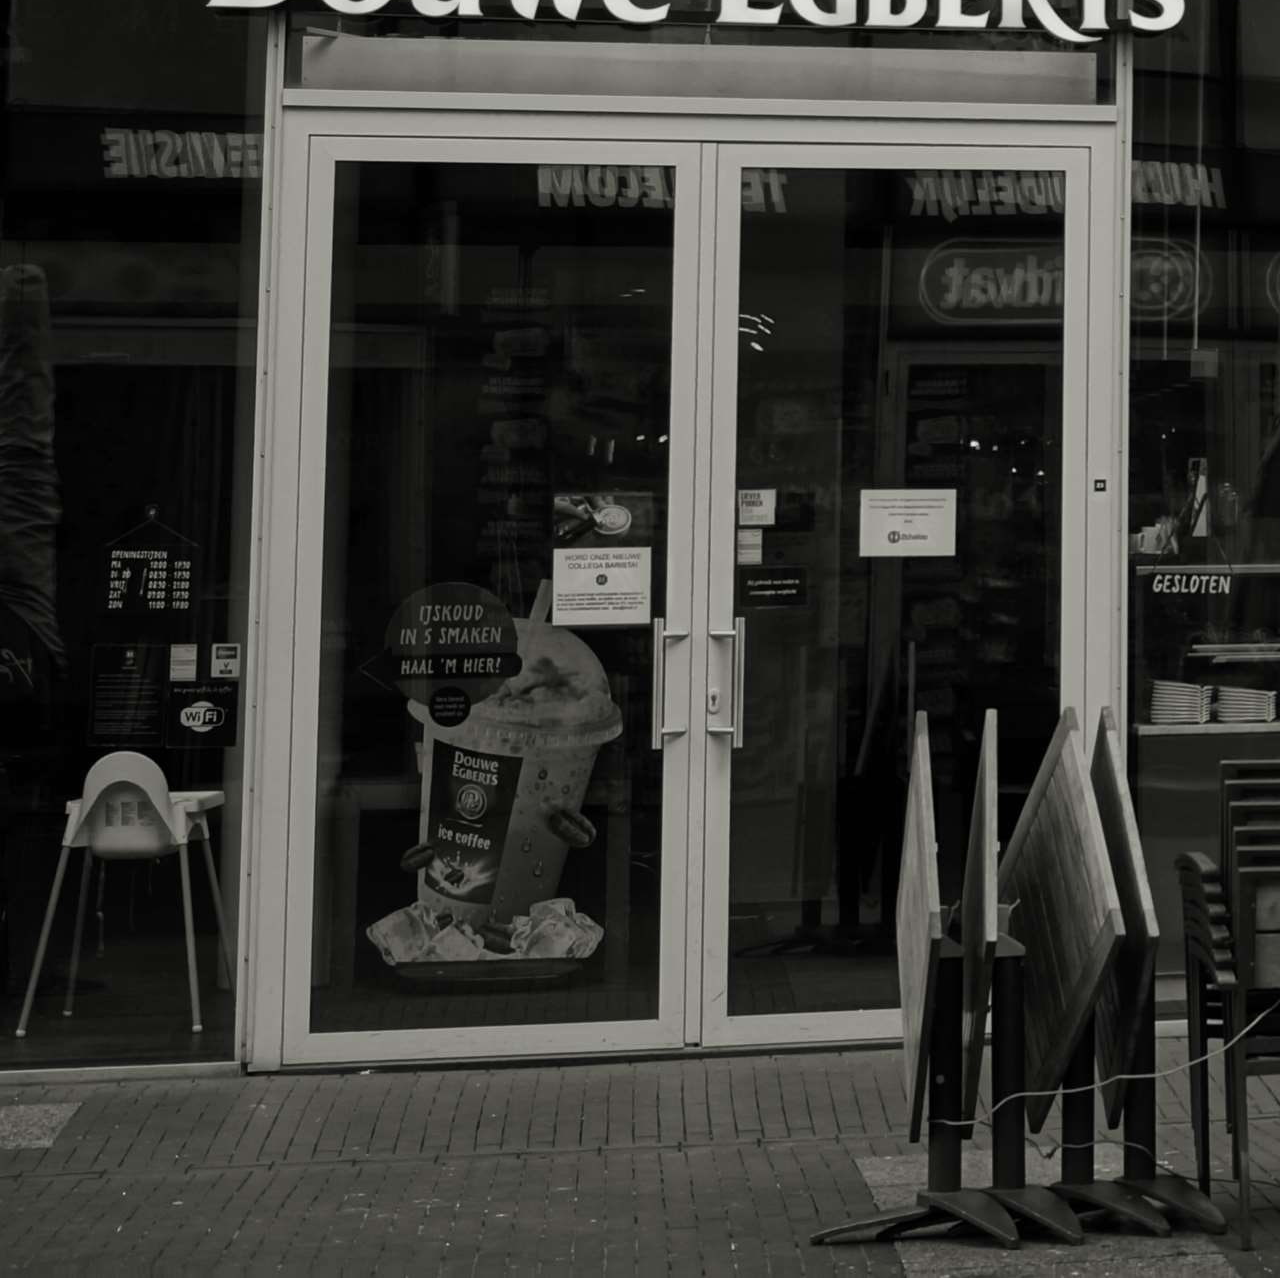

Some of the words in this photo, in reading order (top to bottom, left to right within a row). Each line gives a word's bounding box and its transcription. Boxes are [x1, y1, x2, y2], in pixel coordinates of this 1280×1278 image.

[1152, 574, 1231, 594] GESLOTEN
[419, 604, 484, 626] IJSKOUD
[400, 628, 417, 645] IN
[423, 627, 433, 644] 5
[438, 626, 502, 645] SMAKEN
[400, 658, 435, 675] HAAL
[463, 657, 501, 674] HIER!
[454, 750, 499, 773] Douwe
[452, 764, 499, 786] EGBERTS
[438, 823, 453, 841] ice
[455, 831, 491, 850] coffee
